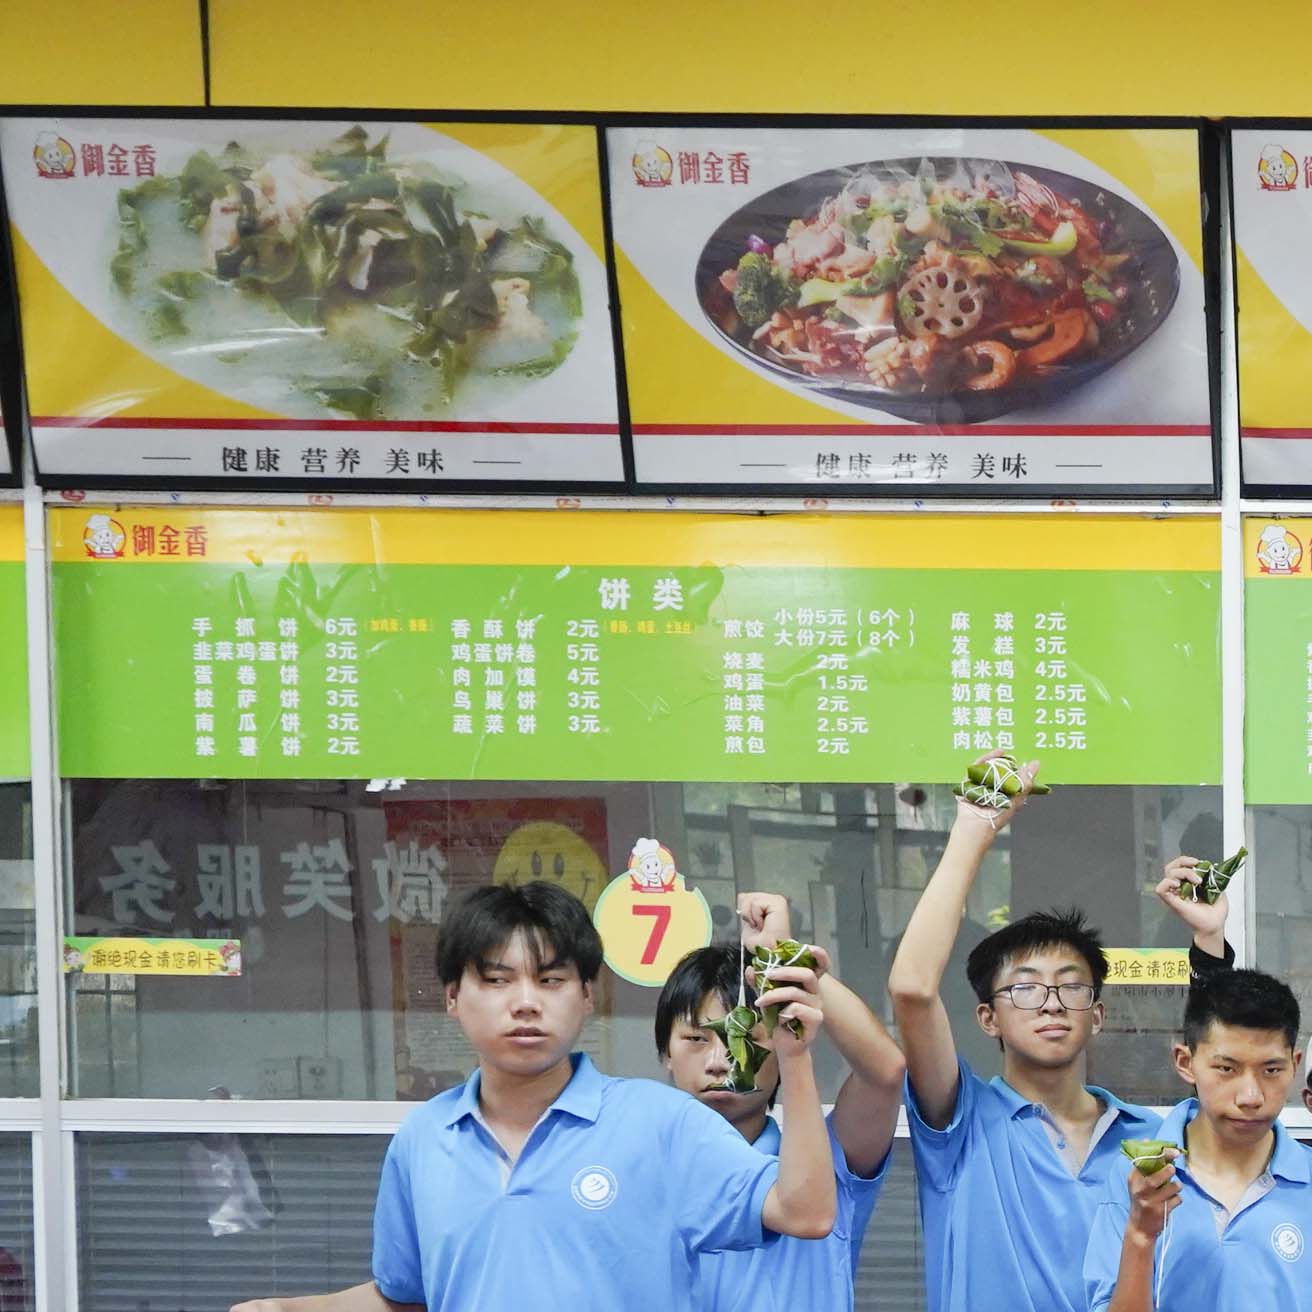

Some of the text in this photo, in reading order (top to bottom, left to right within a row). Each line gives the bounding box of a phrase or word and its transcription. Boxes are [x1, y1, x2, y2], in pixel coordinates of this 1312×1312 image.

[81, 144, 154, 176] 御金香
[679, 151, 749, 184] 御金香
[222, 447, 443, 473] 健康 营养 美味
[816, 452, 1027, 479] 健康 营养 美味
[132, 524, 205, 556] 御金香
[598, 578, 683, 611] 饼类
[192, 617, 298, 638] 手抓饼
[324, 618, 357, 636] 6元
[451, 618, 537, 639] 香酥饼
[567, 619, 599, 638] 2元
[951, 612, 1066, 631] 麻球 2元
[194, 641, 358, 661] 韭菜鸡蛋饼 3元
[452, 643, 600, 663] 鸡蛋饼卷 5元
[952, 635, 1067, 655] 发糕 3元
[817, 654, 848, 670] 2元
[1035, 660, 1067, 678] 4元
[194, 664, 358, 685] 蛋卷饼 2元
[568, 667, 600, 685] 4元
[724, 673, 868, 692] 鸡蛋 1.5元
[326, 689, 359, 707] 3元
[453, 690, 600, 710] 鸟巢饼 3元
[952, 683, 1086, 702] 奶黄包 2.5元
[724, 695, 848, 712] 油菜 2元
[195, 713, 359, 733] 南瓜饼 3元
[453, 714, 600, 734] 蔬菜饼 3元
[725, 715, 868, 734] 菜角 2.5元
[952, 707, 1087, 726] 紫薯包 2.5元
[328, 736, 360, 755] 2元
[725, 736, 849, 754] 煎包 2元
[954, 730, 1086, 750] 肉松包 2.5元
[632, 904, 672, 965] 7
